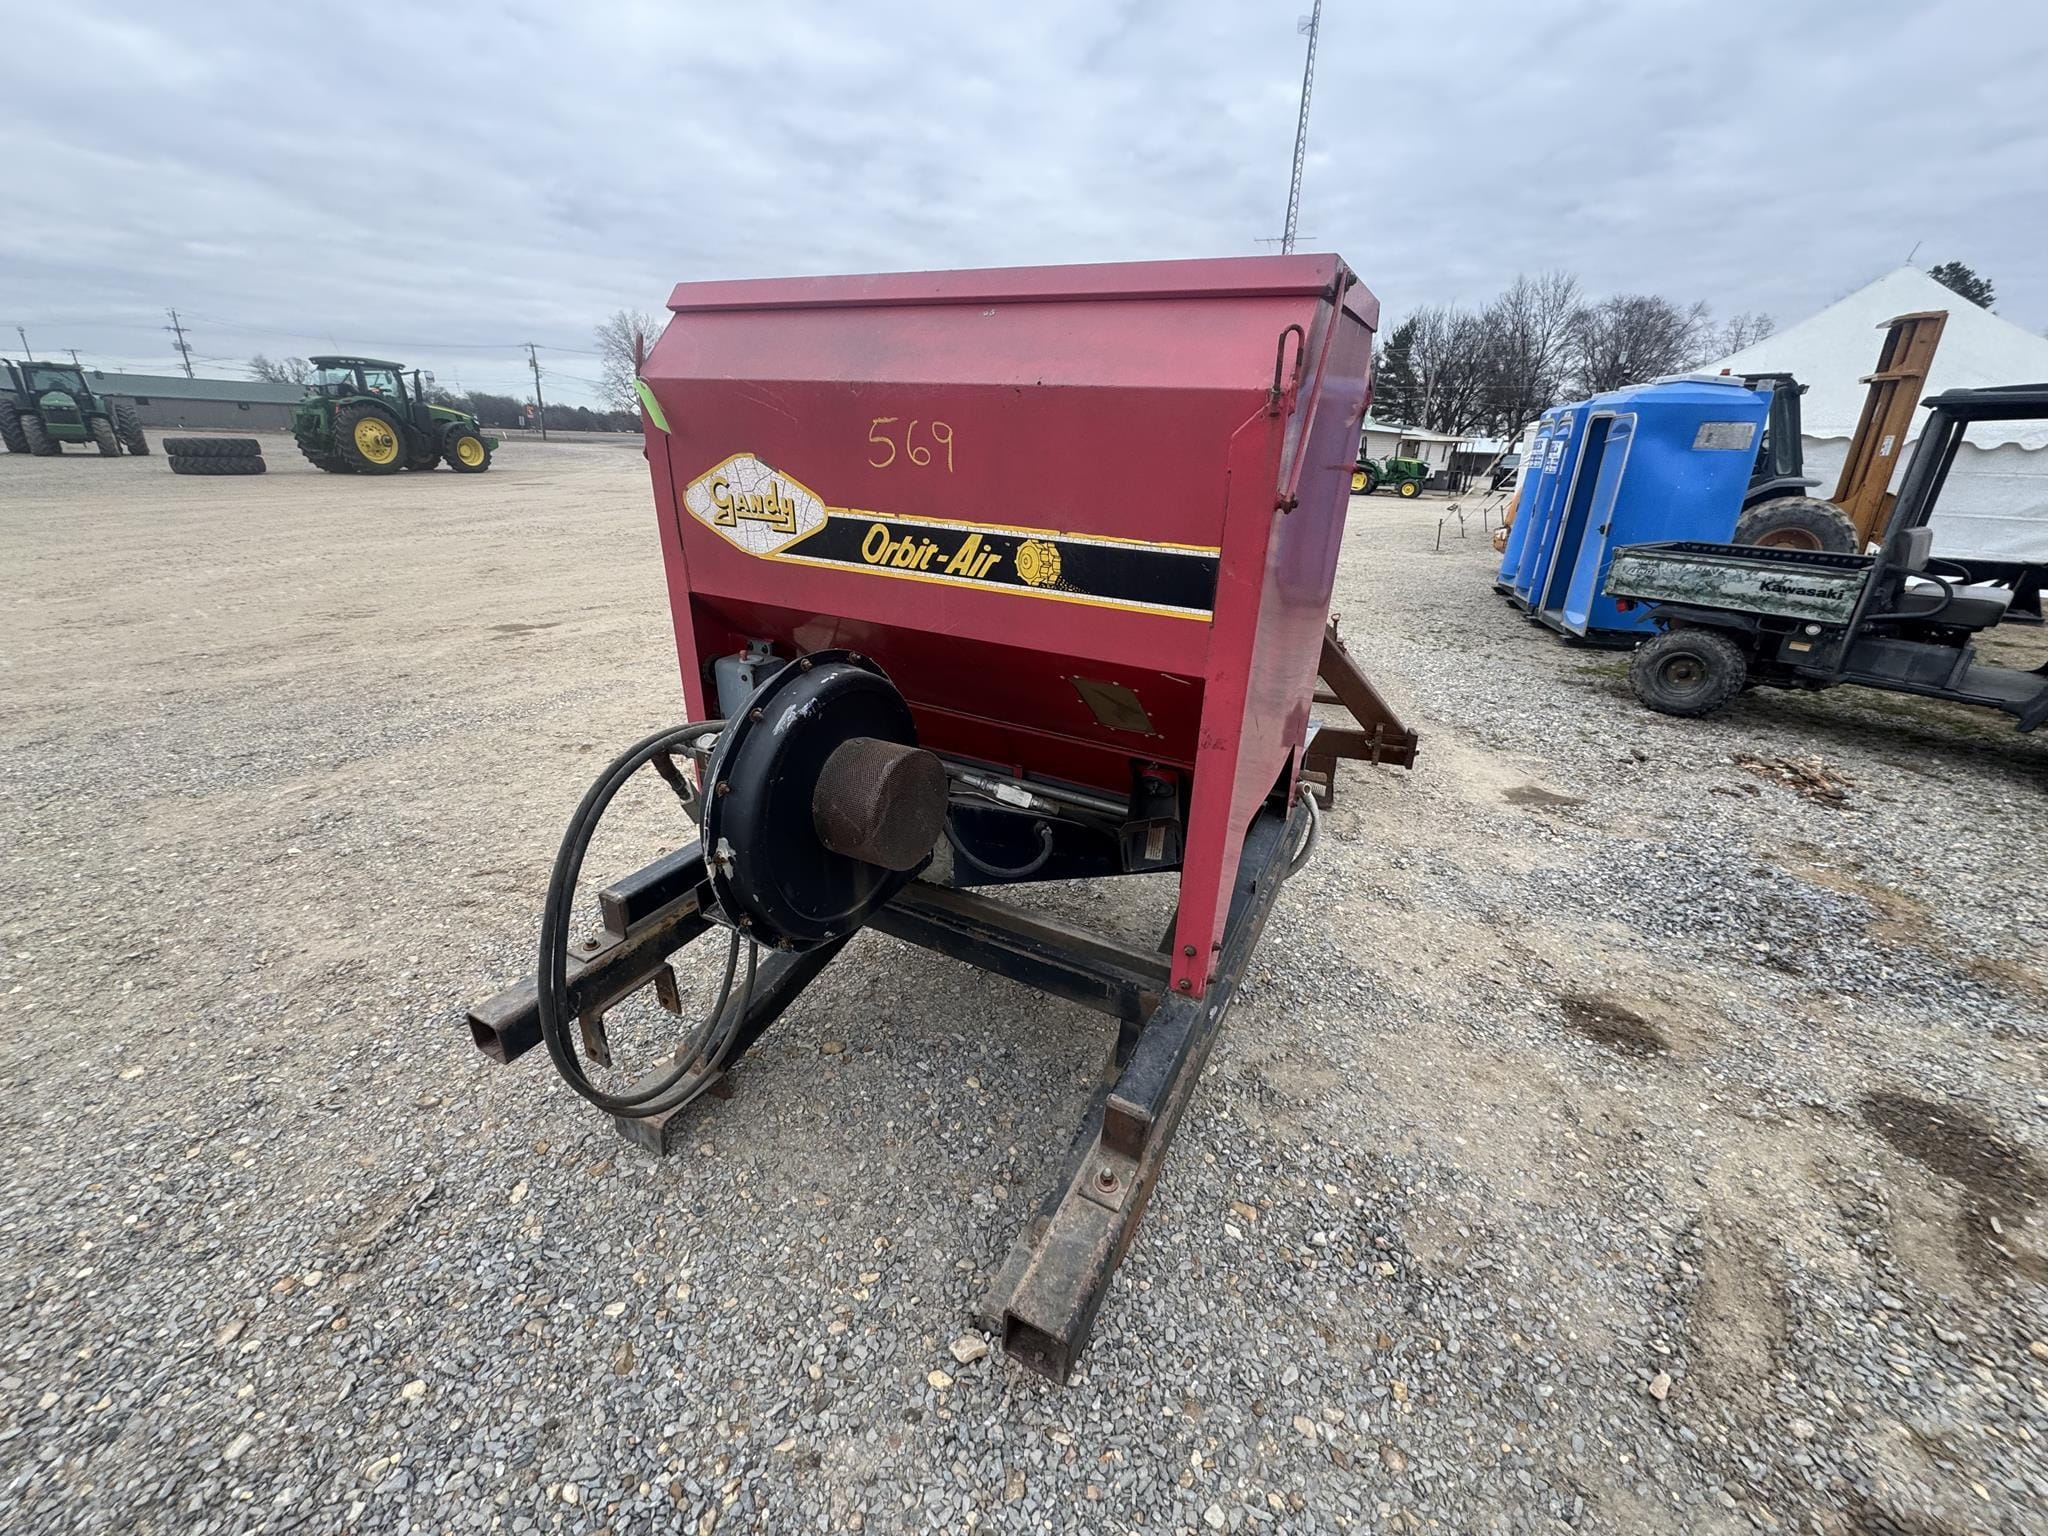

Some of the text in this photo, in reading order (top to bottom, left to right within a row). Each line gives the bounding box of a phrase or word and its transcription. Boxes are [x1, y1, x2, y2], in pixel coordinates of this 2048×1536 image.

[868, 417, 953, 473] 569
[861, 522, 1002, 579] Orbit-Air
[1759, 580, 1846, 600] Kawasaki
